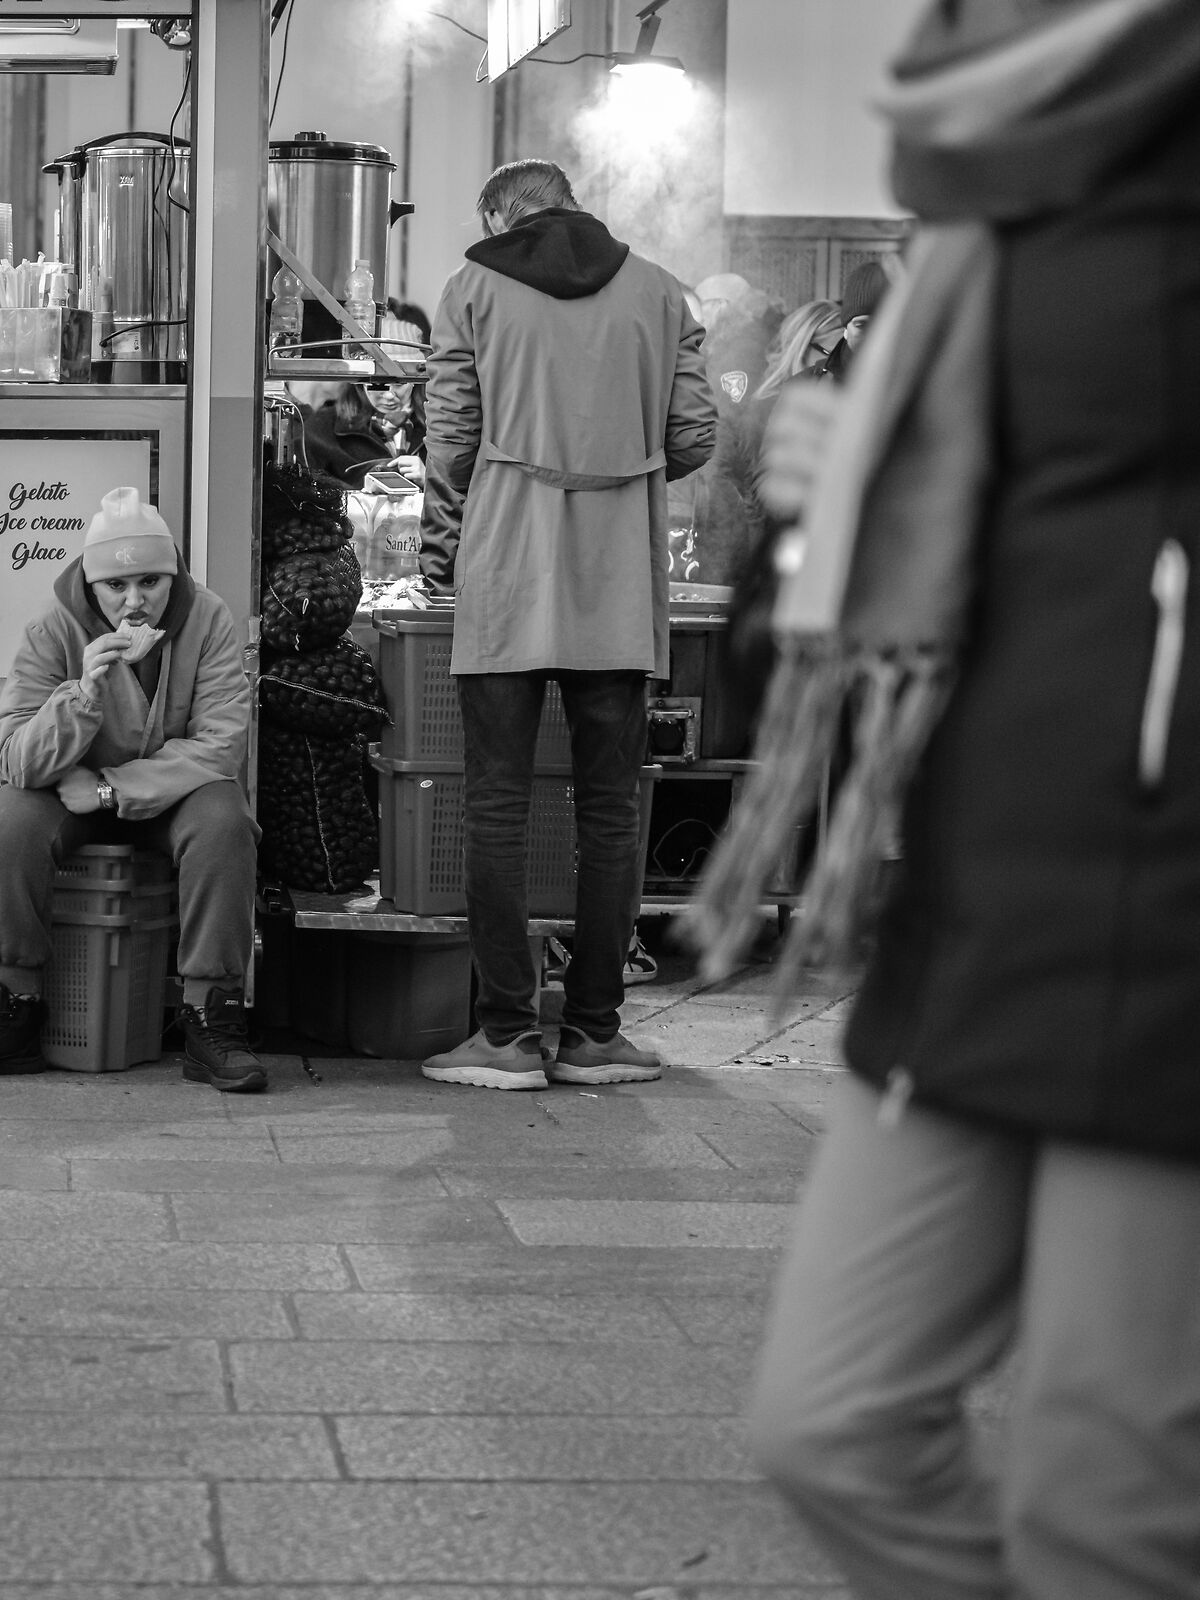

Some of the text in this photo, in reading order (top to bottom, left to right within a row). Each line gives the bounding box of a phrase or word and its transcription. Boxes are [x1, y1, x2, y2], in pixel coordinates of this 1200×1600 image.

[8, 481, 70, 511] Gelato
[30, 516, 86, 531] cream
[11, 541, 67, 570] Glace
